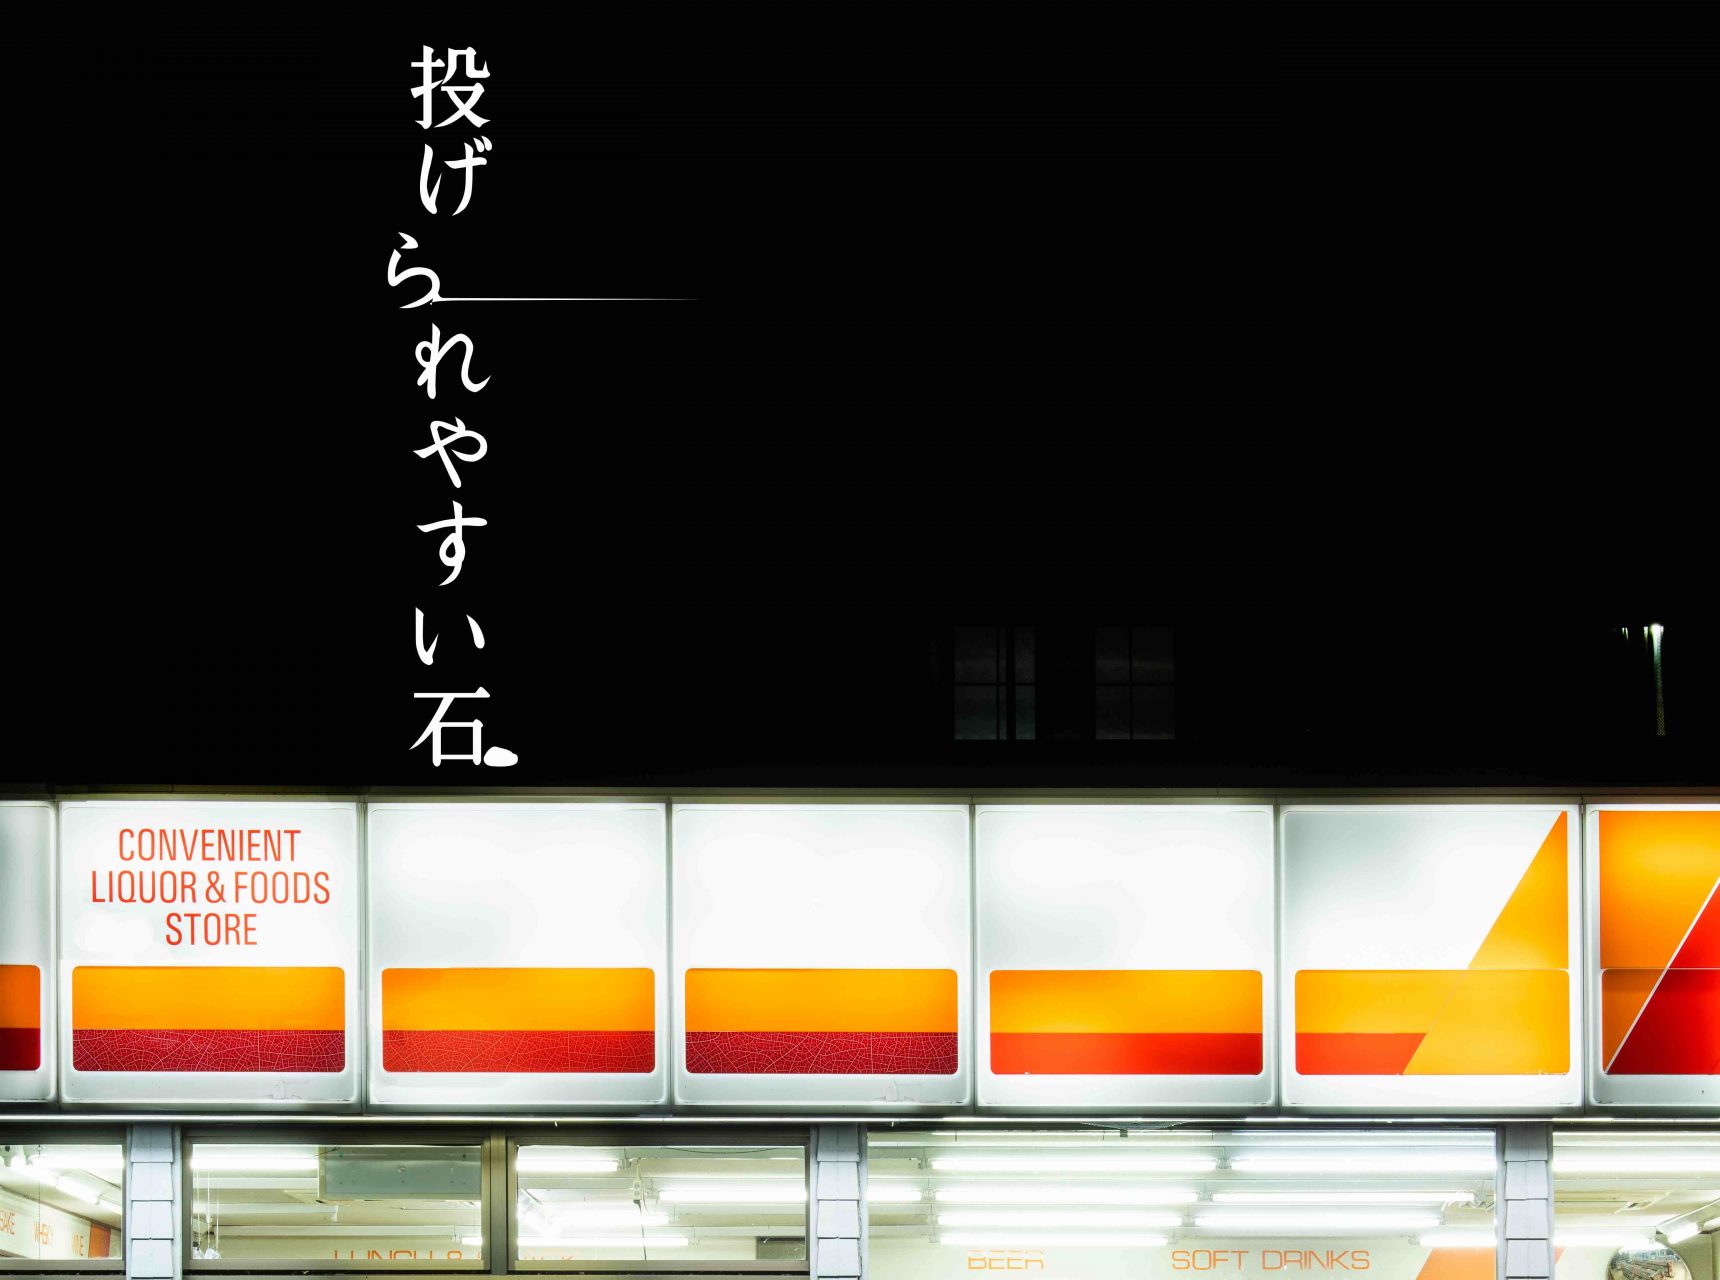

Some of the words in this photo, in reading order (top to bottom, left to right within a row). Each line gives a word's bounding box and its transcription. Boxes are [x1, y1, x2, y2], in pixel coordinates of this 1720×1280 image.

[118, 828, 301, 862] CONVENIENT
[91, 871, 196, 903] LIQUOR
[205, 871, 226, 903] &
[234, 871, 330, 904] FOODS
[165, 912, 257, 945] STORE
[968, 1250, 1044, 1270] BEER
[1172, 1250, 1249, 1270] SOFT
[1262, 1250, 1371, 1270] DRINKS
